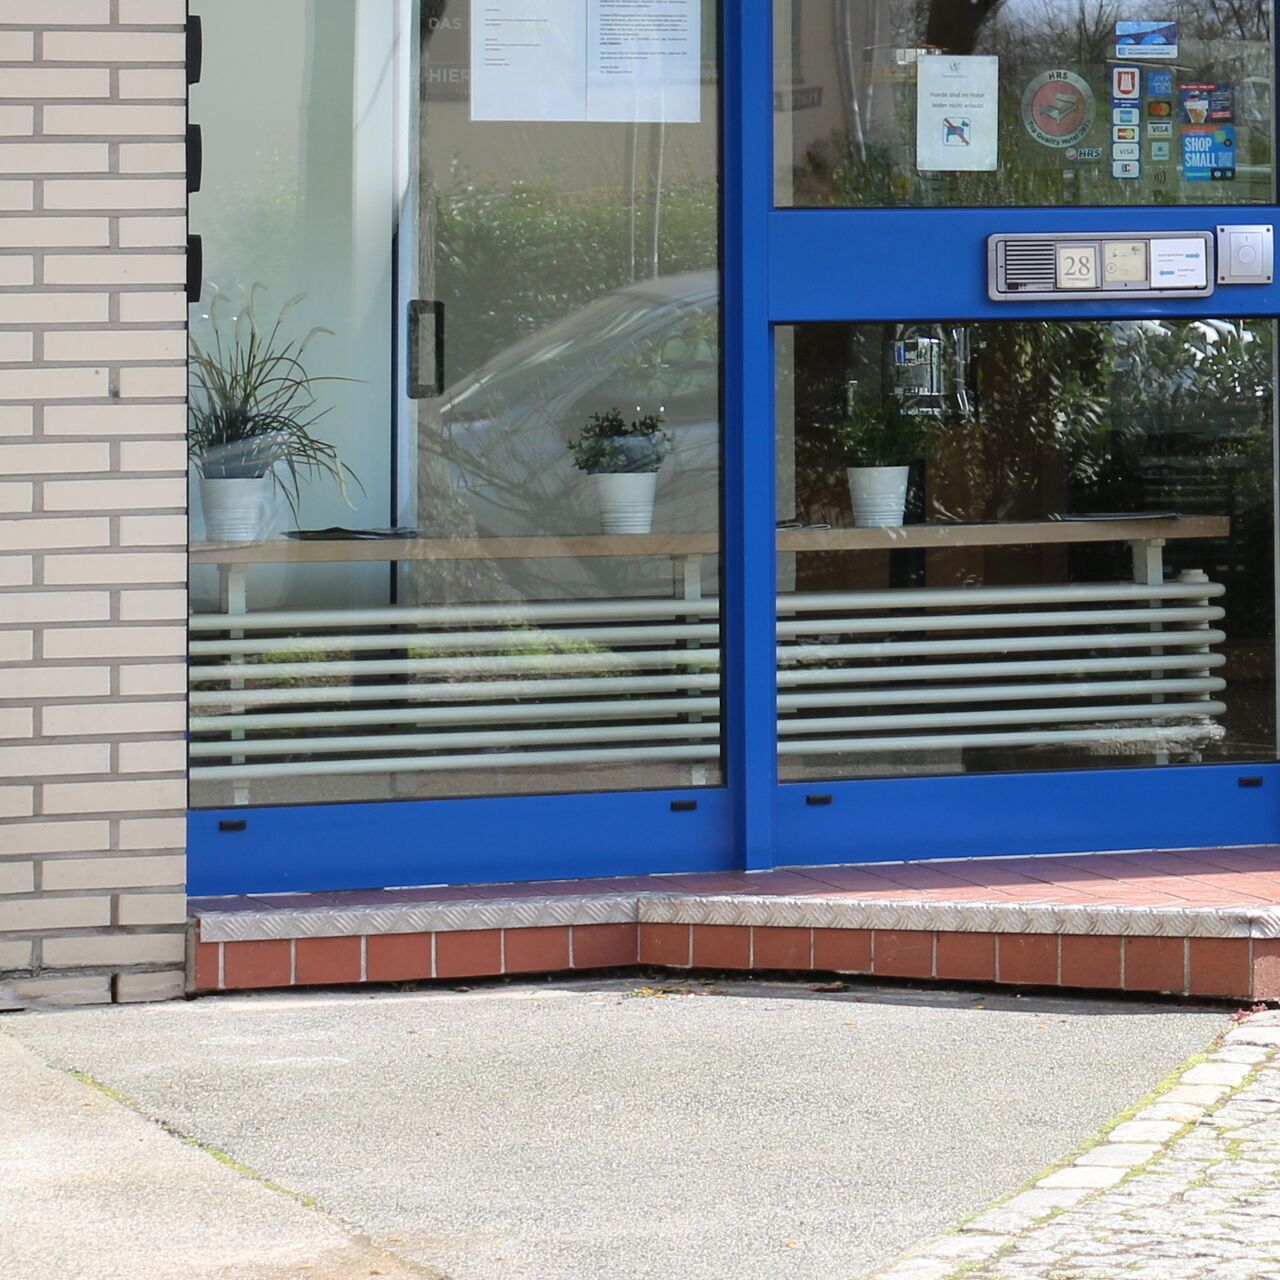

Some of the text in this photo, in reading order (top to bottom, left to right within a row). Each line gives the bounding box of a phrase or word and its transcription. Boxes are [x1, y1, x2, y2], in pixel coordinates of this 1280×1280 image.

[428, 17, 462, 30] DAS
[1048, 71, 1069, 80] HRS
[1028, 121, 1037, 133] Top
[1037, 133, 1060, 145] Quality
[1062, 134, 1080, 144] Hotel
[1151, 125, 1169, 133] VISA
[1185, 137, 1212, 152] SHOP
[1078, 149, 1102, 159] HRS
[1185, 152, 1217, 167] SMALL
[1064, 256, 1090, 276] 28
